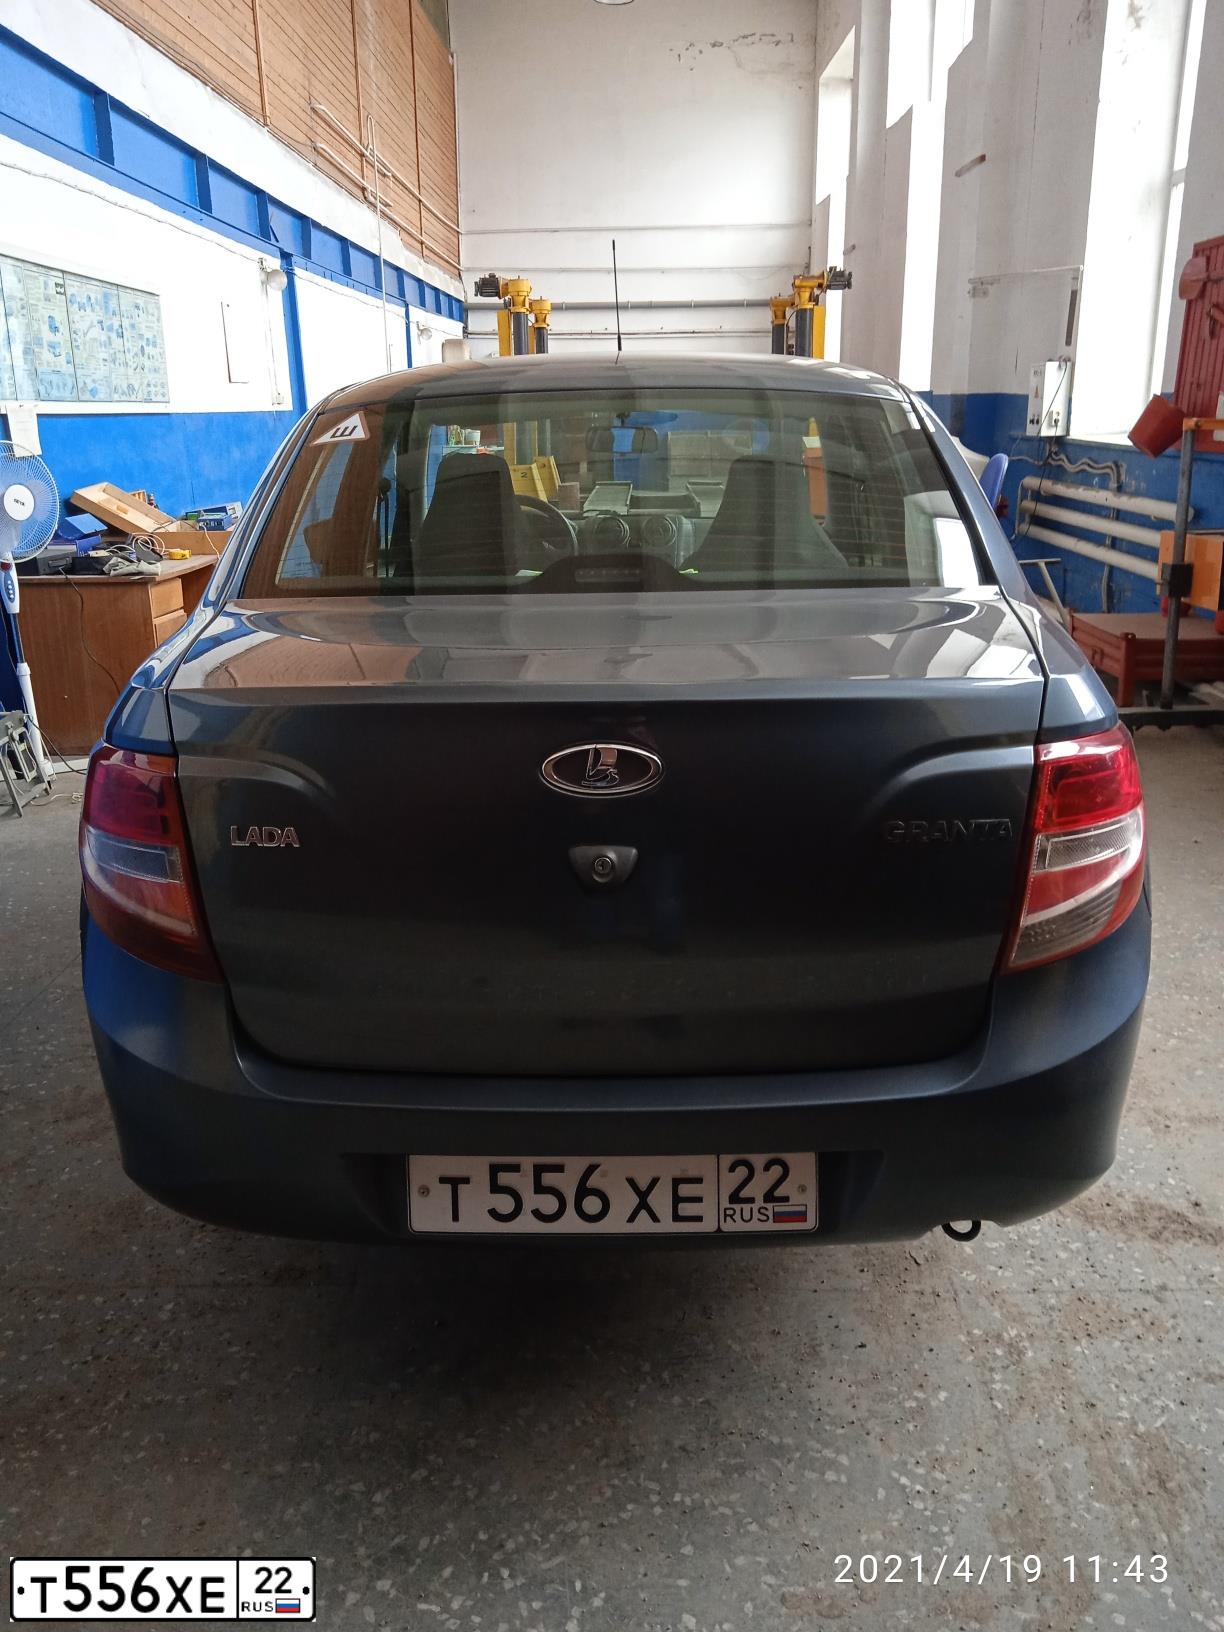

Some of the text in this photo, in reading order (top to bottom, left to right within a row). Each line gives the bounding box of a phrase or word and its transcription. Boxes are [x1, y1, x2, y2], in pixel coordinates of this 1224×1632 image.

[230, 825, 300, 848] LADA
[885, 818, 1013, 842] GRANTA
[727, 1158, 790, 1204] 22
[723, 1206, 770, 1223] RUS
